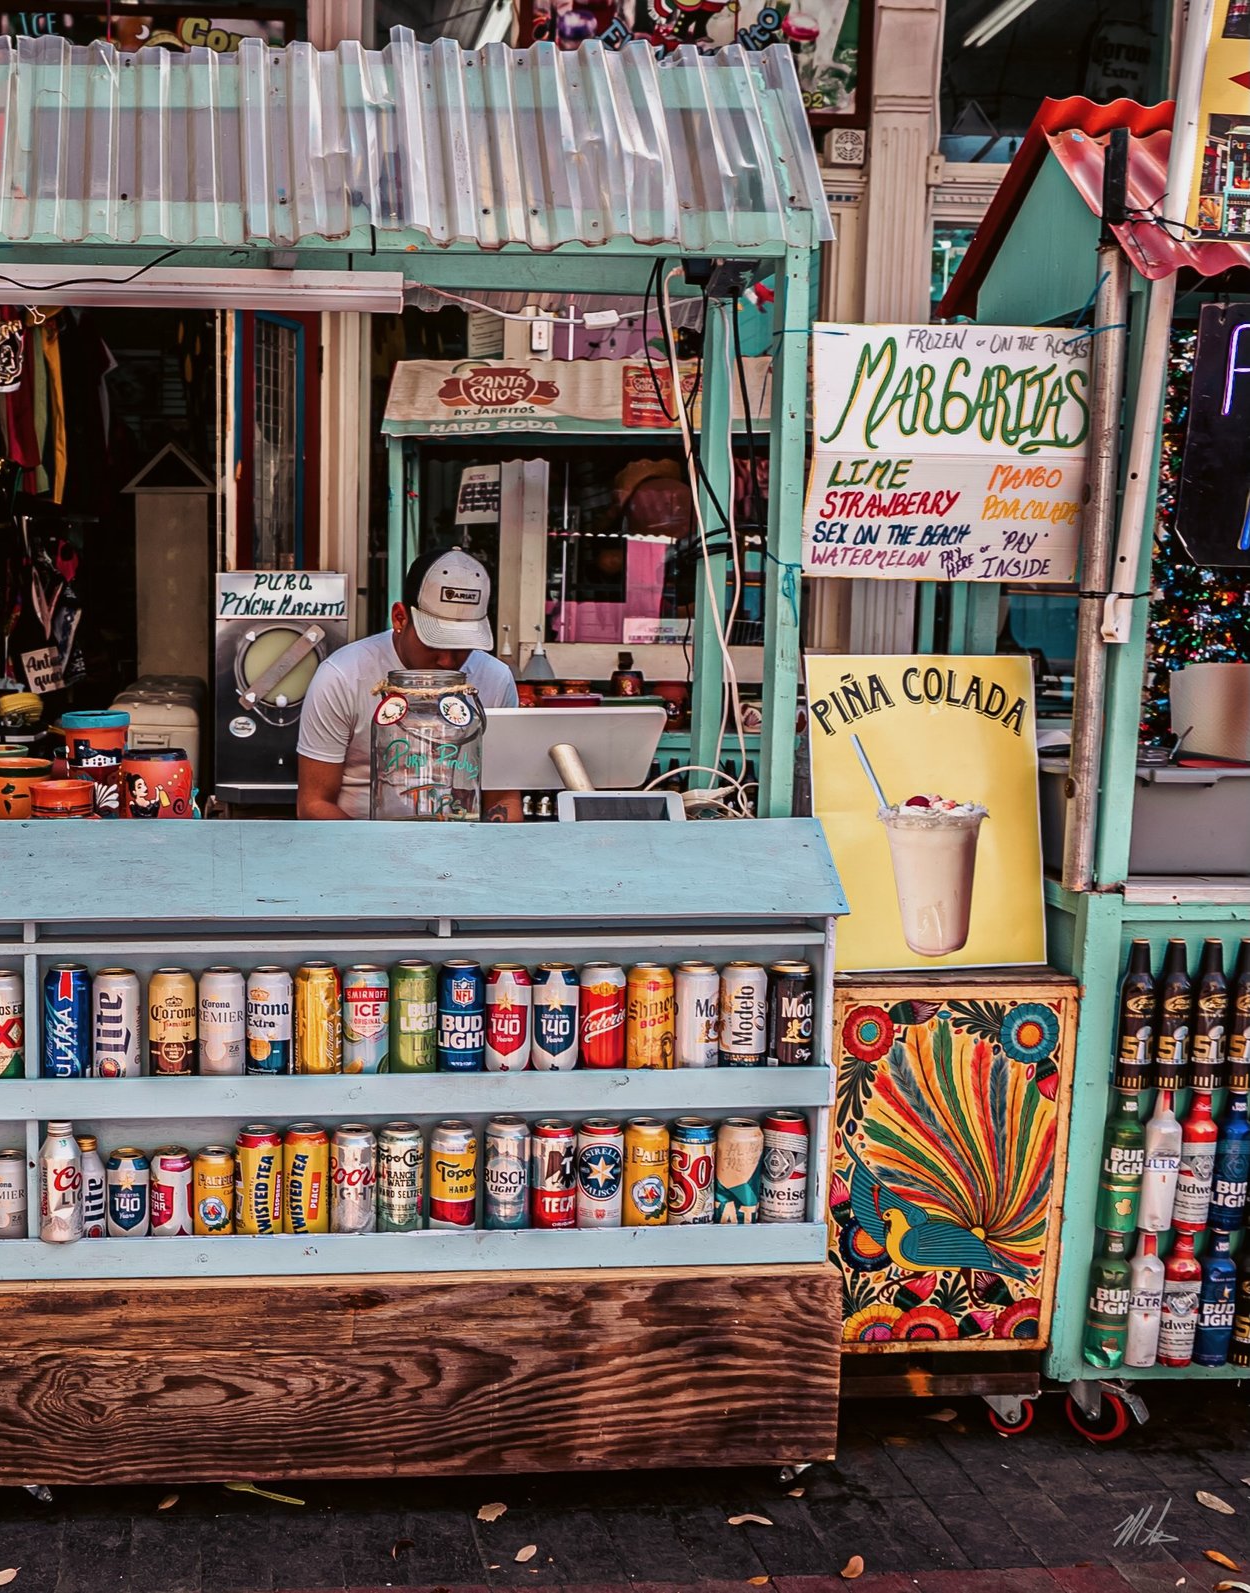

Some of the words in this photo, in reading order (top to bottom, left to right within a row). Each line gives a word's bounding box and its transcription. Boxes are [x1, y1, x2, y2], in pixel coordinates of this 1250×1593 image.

[905, 328, 970, 353] FROZEN
[990, 333, 1015, 354] ON
[1017, 335, 1037, 352] THE
[1045, 333, 1091, 363] ROCKS
[820, 336, 1091, 456] MARGARITAS
[453, 407, 469, 416] BY
[472, 404, 537, 416] JARRITOS
[429, 420, 491, 434] HARD
[497, 419, 559, 432] SODA
[827, 458, 914, 491] LIME
[987, 463, 1063, 491] MANGO
[819, 489, 961, 521] STRAWBERRY
[812, 520, 849, 545] SEX
[853, 527, 880, 547] ON
[887, 523, 914, 547] THE
[916, 523, 972, 548] BEACH
[811, 545, 931, 571] WATERMELON
[938, 546, 964, 570] PAY
[977, 557, 1052, 580] INSIDE
[453, 592, 478, 602] ARIAT
[810, 671, 898, 737] PIÑA
[900, 666, 1028, 737] COLADA
[200, 998, 231, 1010] Corona
[346, 989, 389, 1001] SMIRNOFF
[454, 989, 474, 1003] NFL
[150, 1006, 197, 1022] Corona
[354, 1003, 381, 1018] ICE
[731, 985, 756, 1047] Modelo
[441, 1014, 483, 1032] BUD
[490, 1018, 521, 1035] 140
[540, 1018, 570, 1036] 140
[639, 1013, 670, 1030] BOCK
[54, 1006, 73, 1078] ULTRA
[437, 1031, 485, 1049] LIGHT
[291, 1153, 309, 1178] TEA
[581, 1147, 622, 1166] ESTRELLA
[256, 1154, 275, 1180] TEA
[387, 1170, 417, 1180] RANCH
[436, 1160, 474, 1183] Topo
[388, 1178, 417, 1188] WATER
[484, 1169, 528, 1186] BUSCH
[309, 1182, 320, 1210] PEACH
[448, 1184, 467, 1194] HARD
[490, 1184, 519, 1194] LIGHT
[583, 1183, 619, 1198] JALISCO
[114, 1196, 140, 1212] 140
